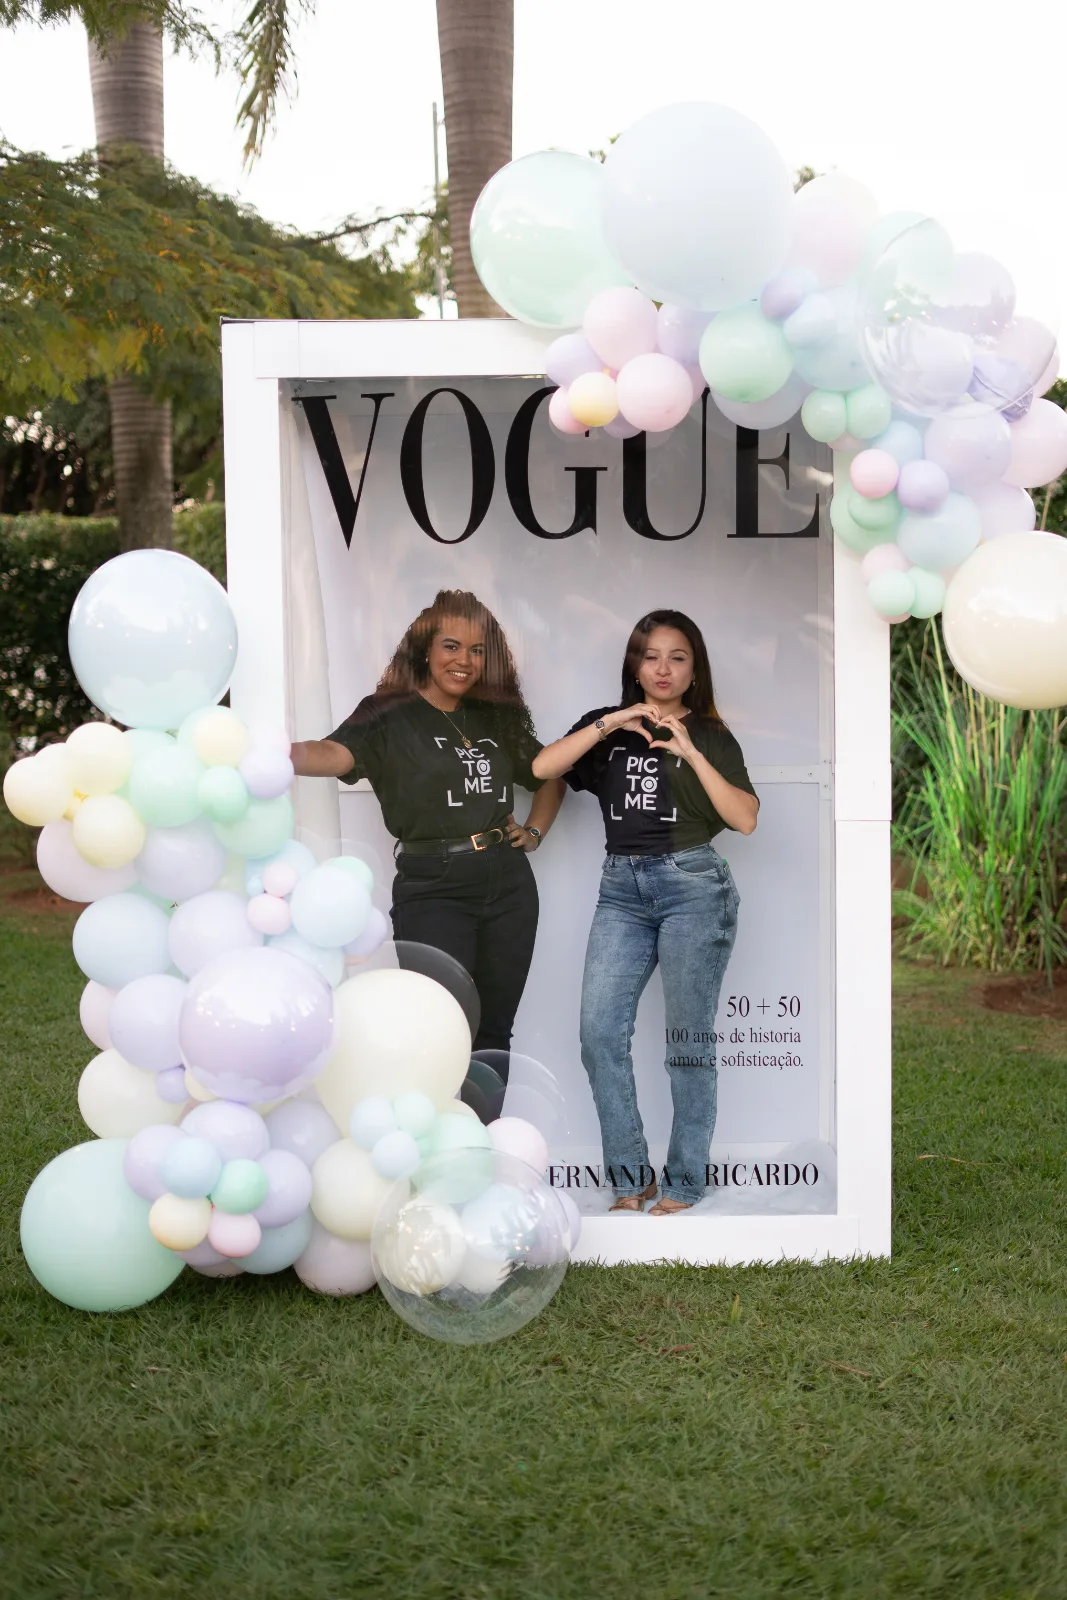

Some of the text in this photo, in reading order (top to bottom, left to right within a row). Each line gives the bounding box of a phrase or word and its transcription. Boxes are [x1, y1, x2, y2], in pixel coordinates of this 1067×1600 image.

[292, 387, 819, 550] VOGUE
[462, 759, 491, 776] TO
[626, 756, 658, 773] PIC
[464, 776, 493, 794] ME
[626, 775, 659, 793] TO
[624, 793, 657, 810] ME
[727, 995, 801, 1018] 50 + 50
[664, 1027, 802, 1044] 100 anos de historia
[669, 1051, 804, 1070] amor e sofisticação.
[545, 1162, 819, 1188] ERNANDA & RICARDO
